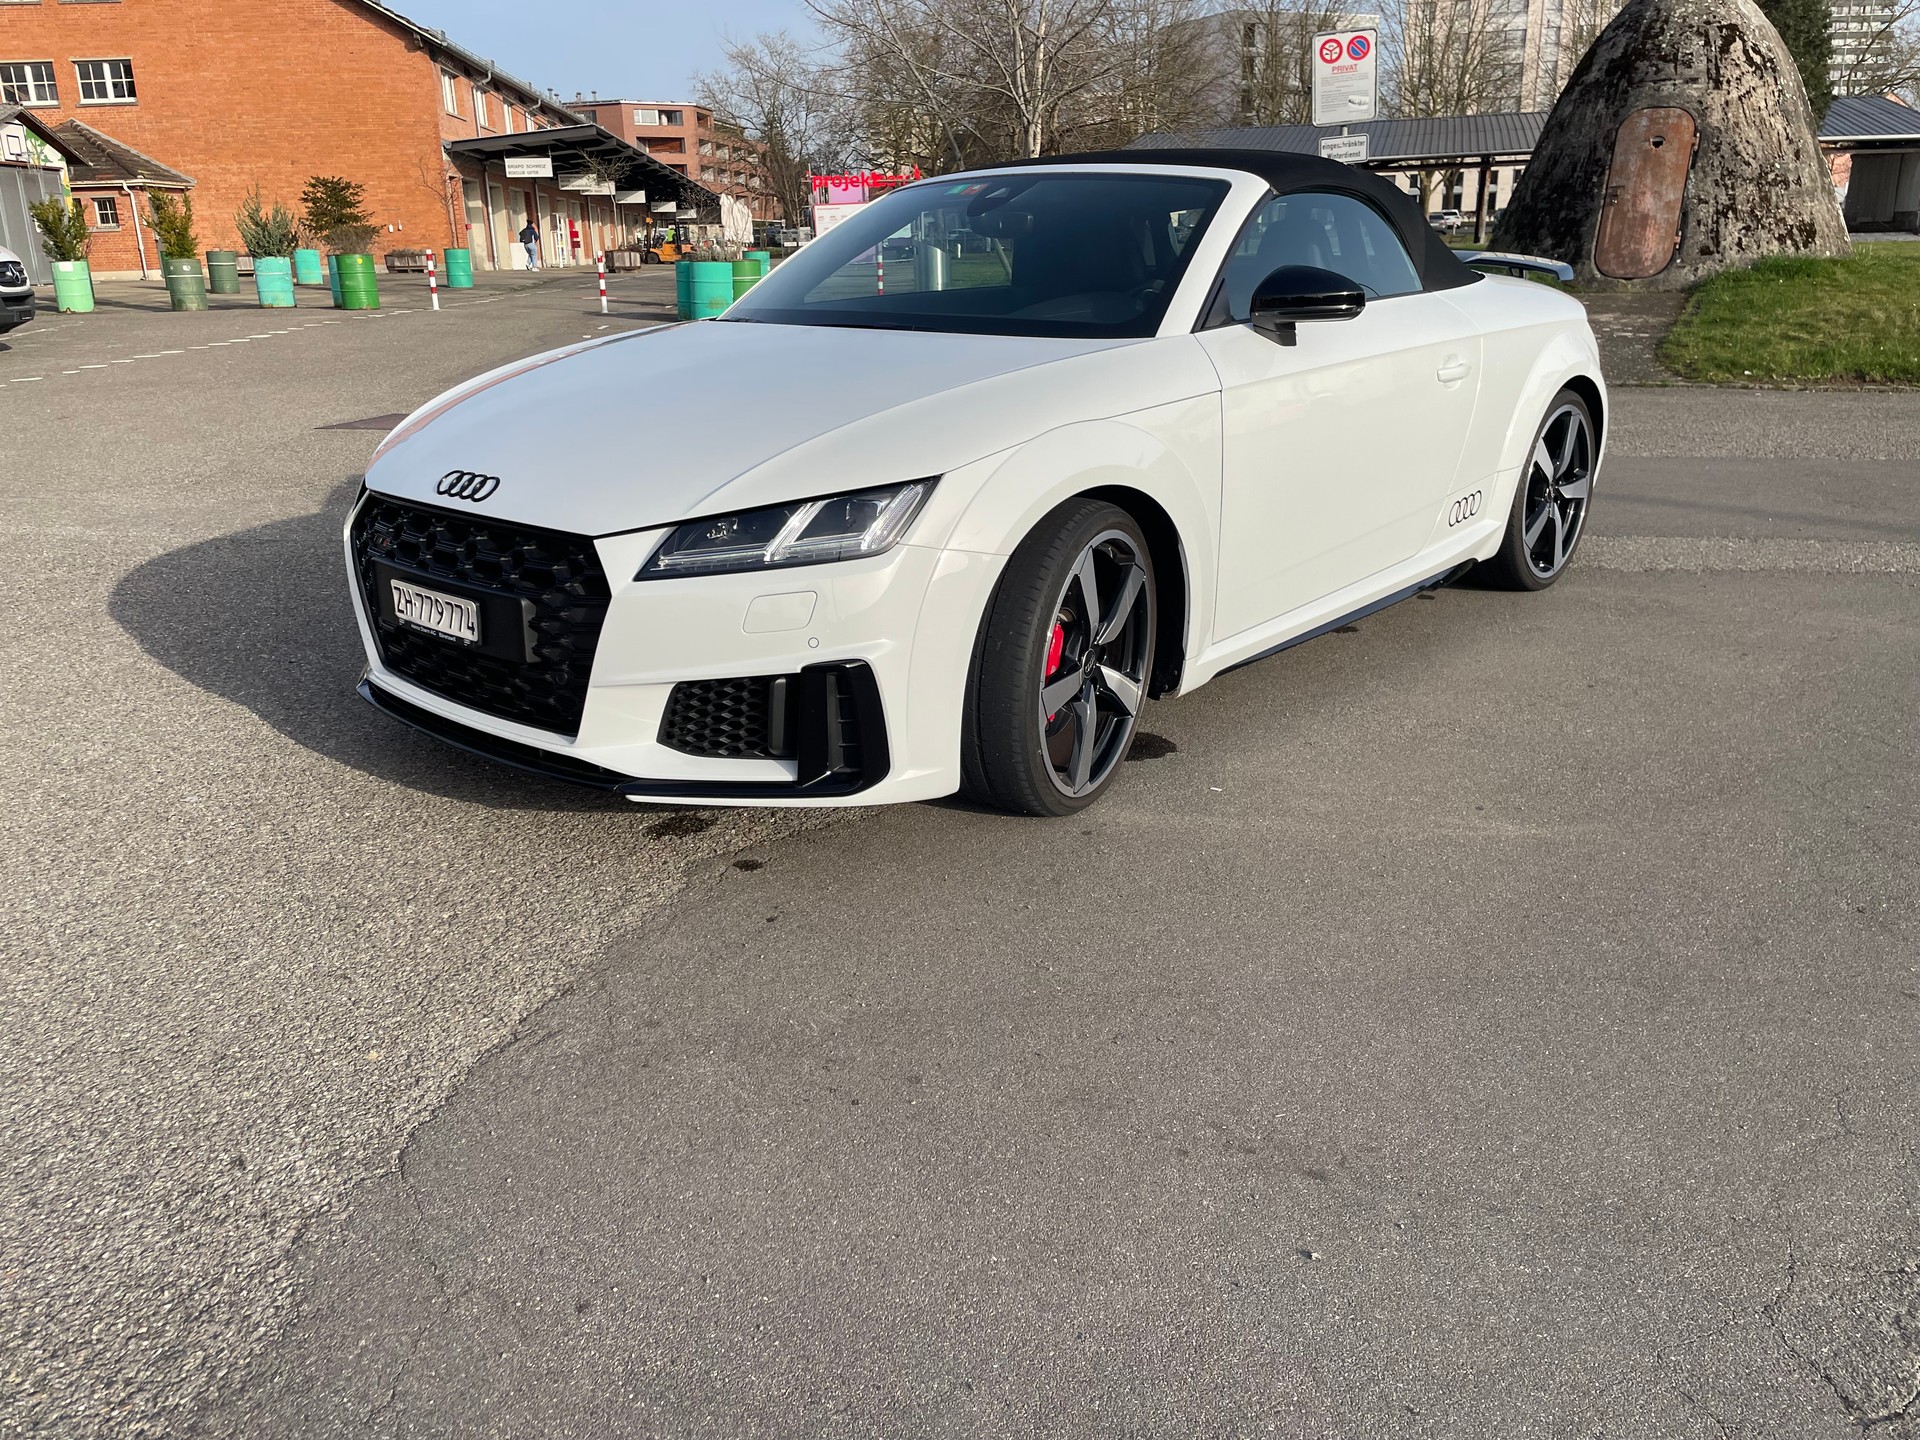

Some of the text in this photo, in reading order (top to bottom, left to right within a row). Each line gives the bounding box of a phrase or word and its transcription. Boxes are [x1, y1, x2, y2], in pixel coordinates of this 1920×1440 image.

[1331, 64, 1358, 73] PRIVAT
[1322, 140, 1366, 151] eingeschränkter
[1326, 151, 1361, 160] Winterdienst
